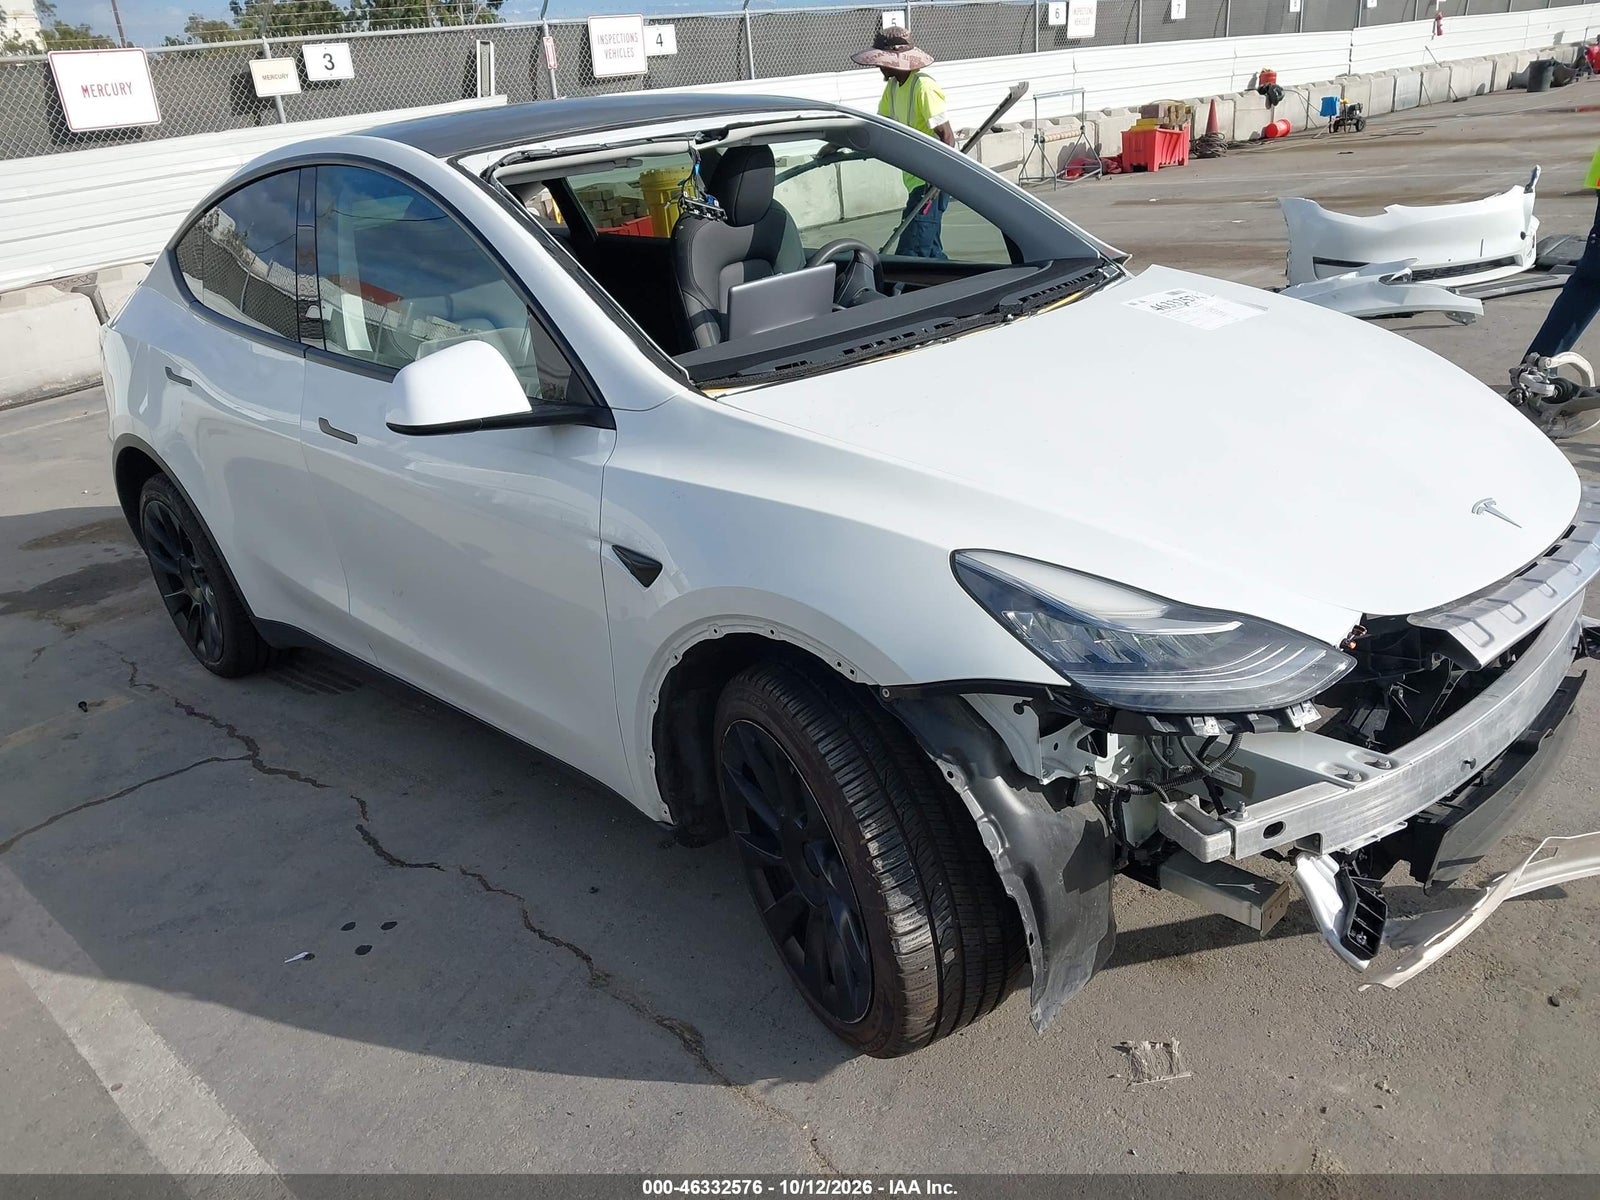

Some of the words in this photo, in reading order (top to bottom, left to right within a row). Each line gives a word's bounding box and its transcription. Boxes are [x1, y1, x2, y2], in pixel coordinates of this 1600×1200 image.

[1054, 7, 1060, 19] 6
[597, 32, 638, 45] INSPECTIONS
[655, 33, 664, 47] 4
[604, 47, 635, 60] VEHICLES
[322, 53, 336, 71] 3
[261, 73, 290, 82] MERCURY
[80, 81, 134, 98] MERCURY
